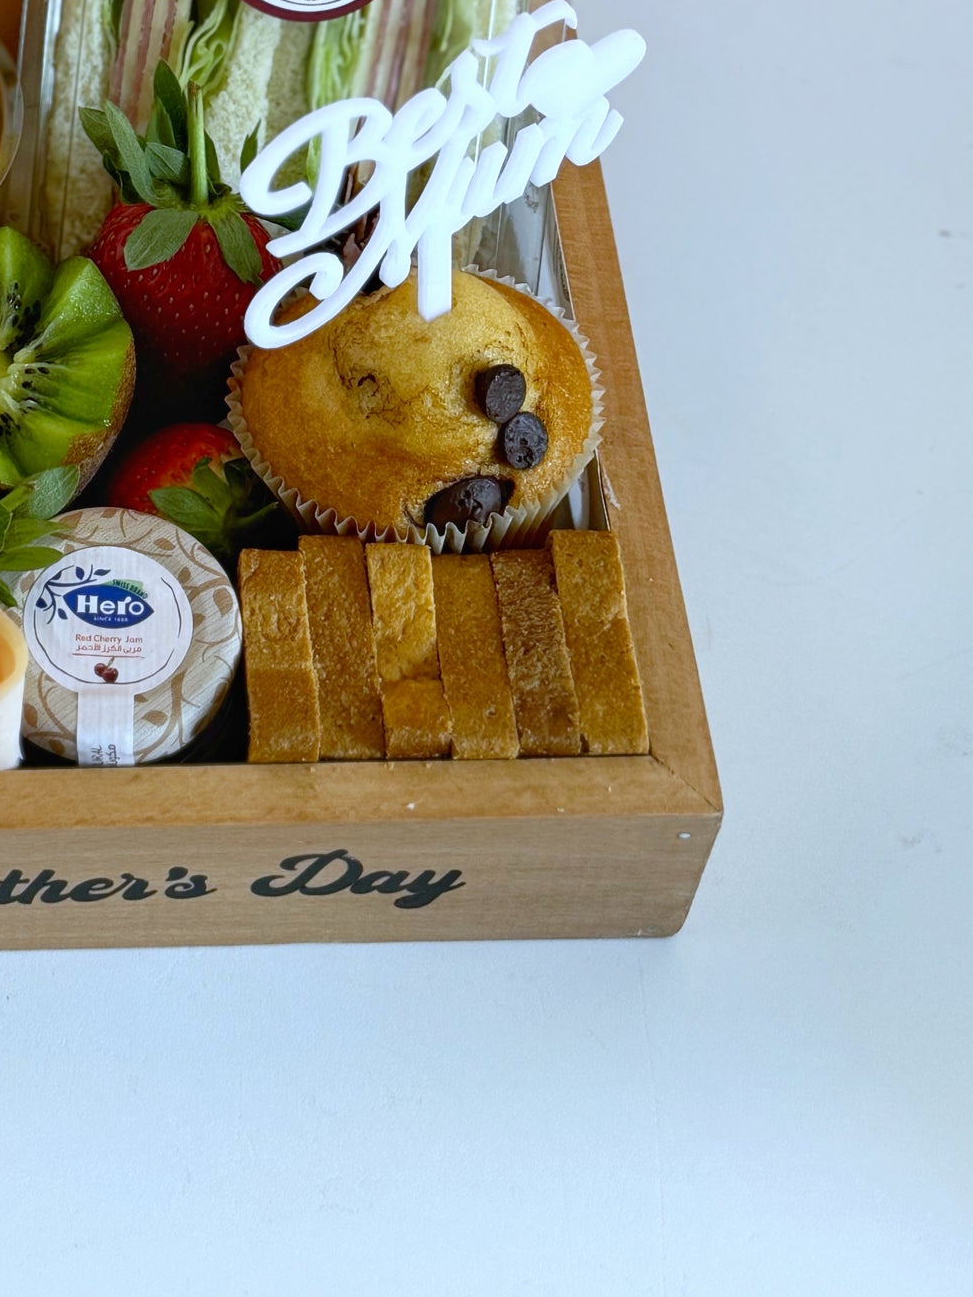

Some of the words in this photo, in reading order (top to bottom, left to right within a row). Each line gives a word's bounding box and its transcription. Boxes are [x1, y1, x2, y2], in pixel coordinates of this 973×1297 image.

[77, 595, 145, 616] Hero
[75, 633, 92, 642] Red
[93, 634, 122, 644] Cherry
[126, 635, 143, 644] Jam
[101, 643, 123, 653] الكرز
[250, 849, 467, 910] Day
